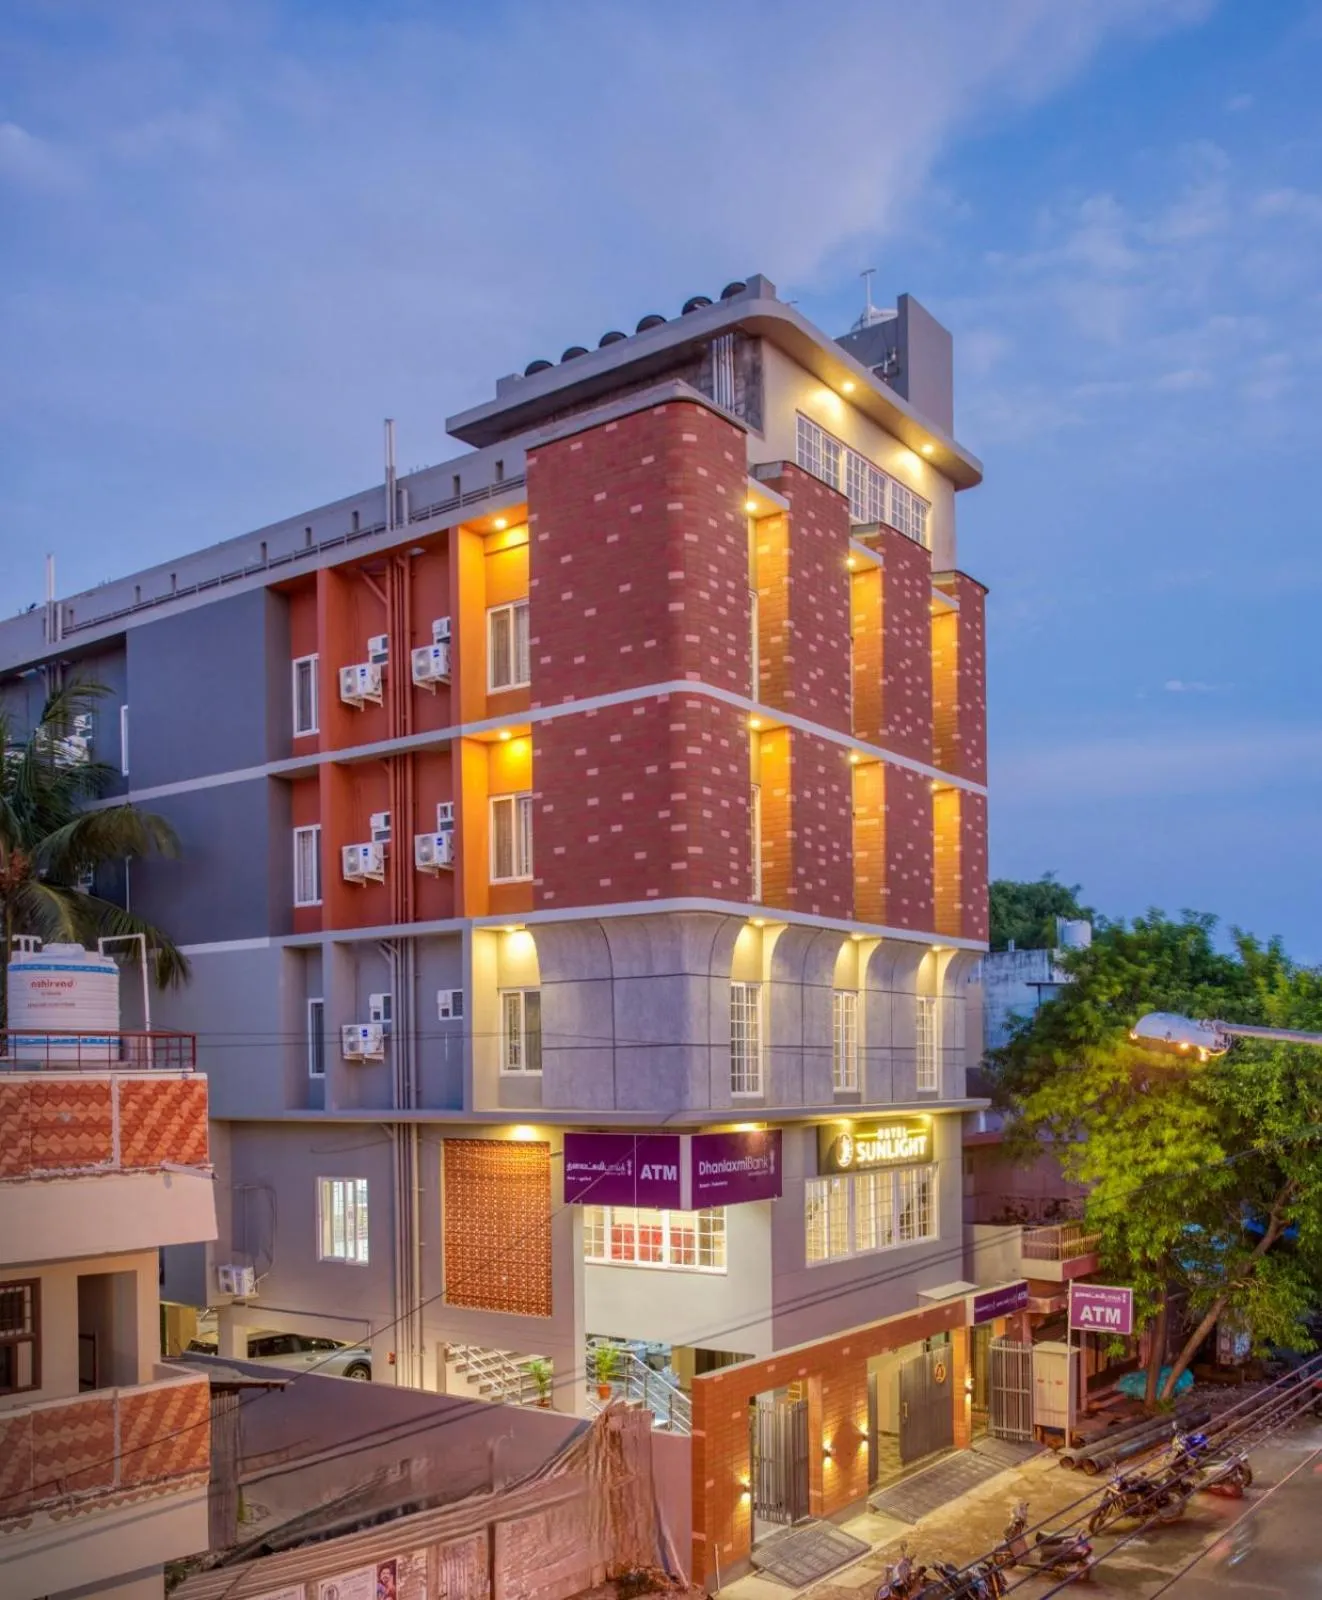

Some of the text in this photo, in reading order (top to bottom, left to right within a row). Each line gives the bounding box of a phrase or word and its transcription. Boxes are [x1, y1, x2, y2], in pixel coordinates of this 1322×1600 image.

[856, 1135, 928, 1162] SUNLIGHT
[640, 1164, 678, 1181] ATM
[1080, 1304, 1121, 1325] ATM
